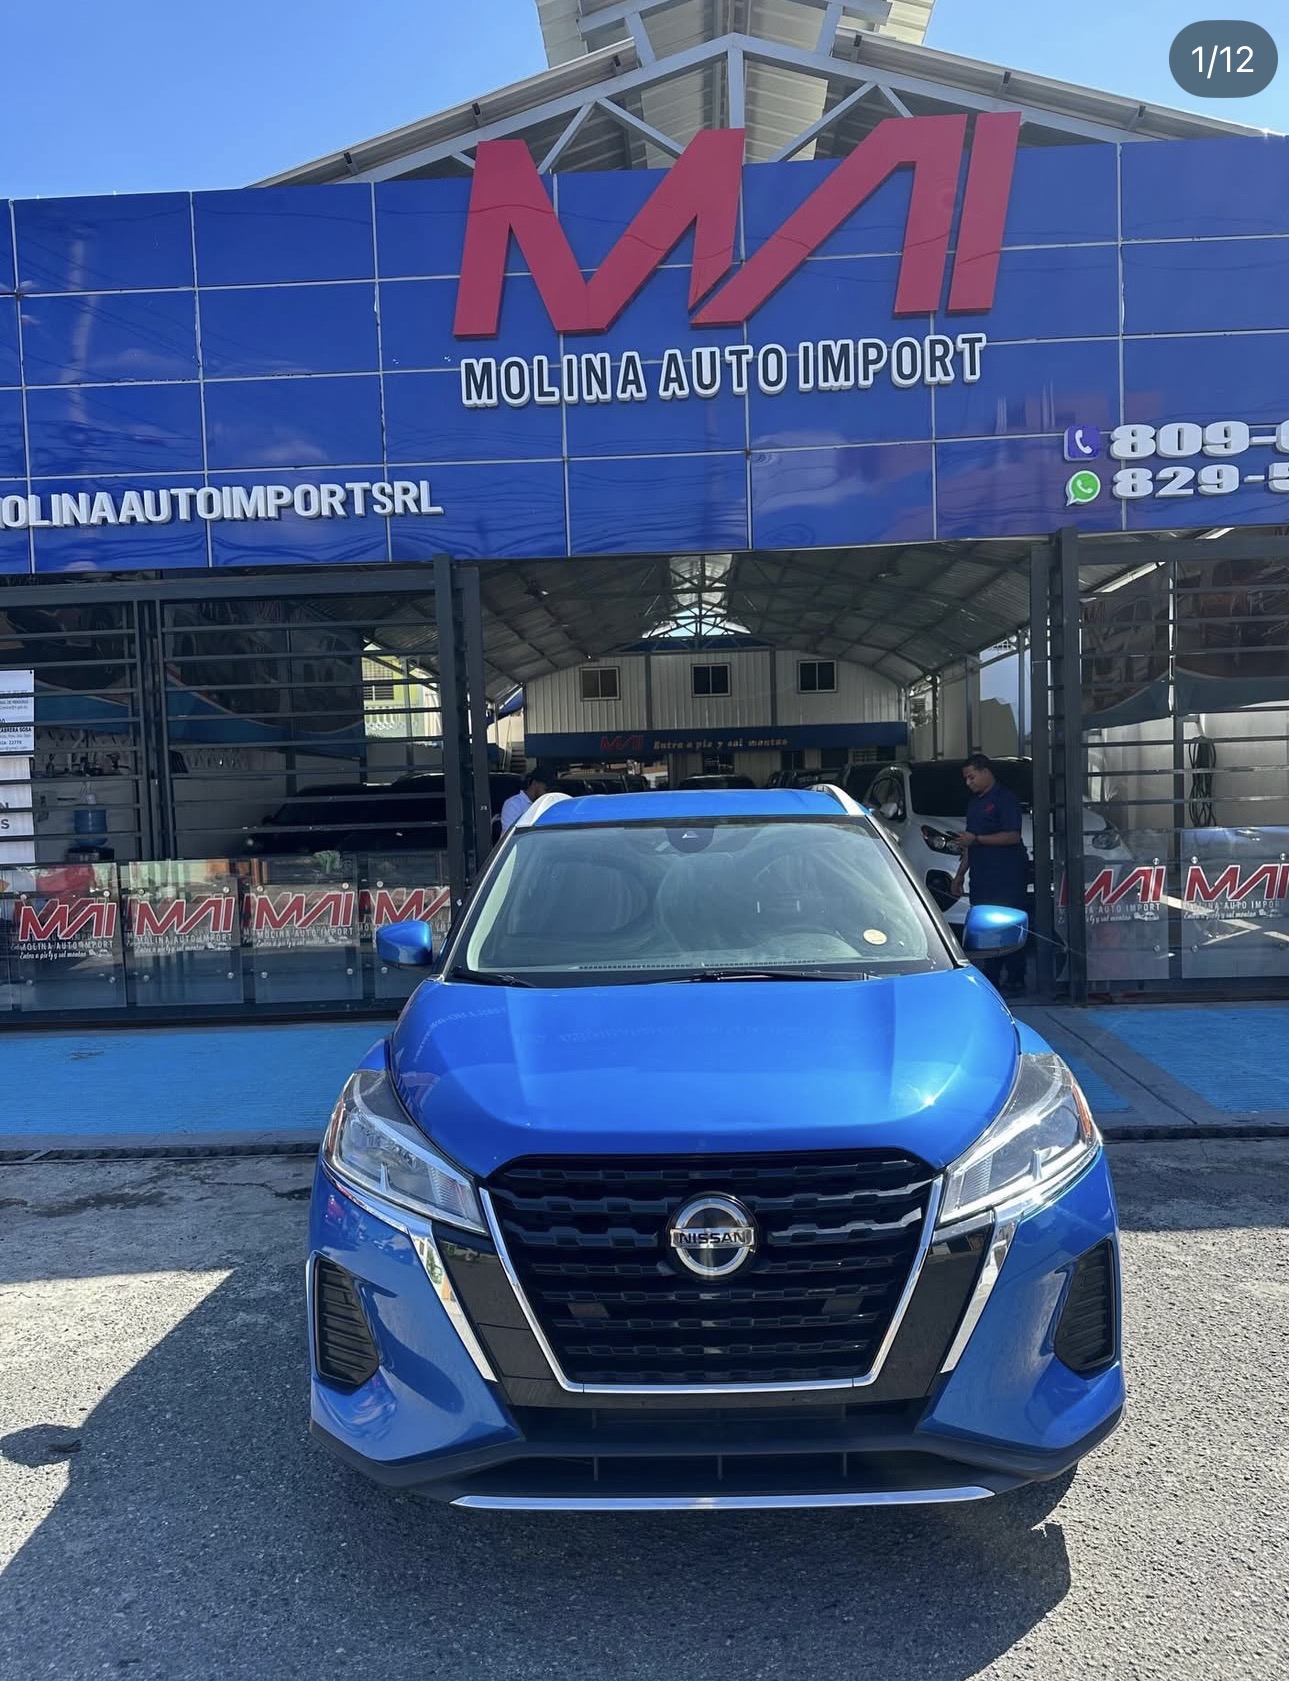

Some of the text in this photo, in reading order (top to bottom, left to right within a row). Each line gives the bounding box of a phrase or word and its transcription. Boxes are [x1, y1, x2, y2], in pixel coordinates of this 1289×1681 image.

[453, 111, 1022, 339] MAI
[460, 332, 987, 409] MOLINA AUTO IMPORT
[1110, 419, 1289, 460] 809-
[0, 480, 444, 530] OLINAAUTOIMPORTSRL
[19, 902, 117, 942] MAI
[135, 897, 235, 937] MAI
[254, 891, 355, 930] MAI
[1125, 902, 1160, 911] IMPORT
[1251, 900, 1280, 908] IMPOR
[679, 1231, 746, 1245] NISSAN
